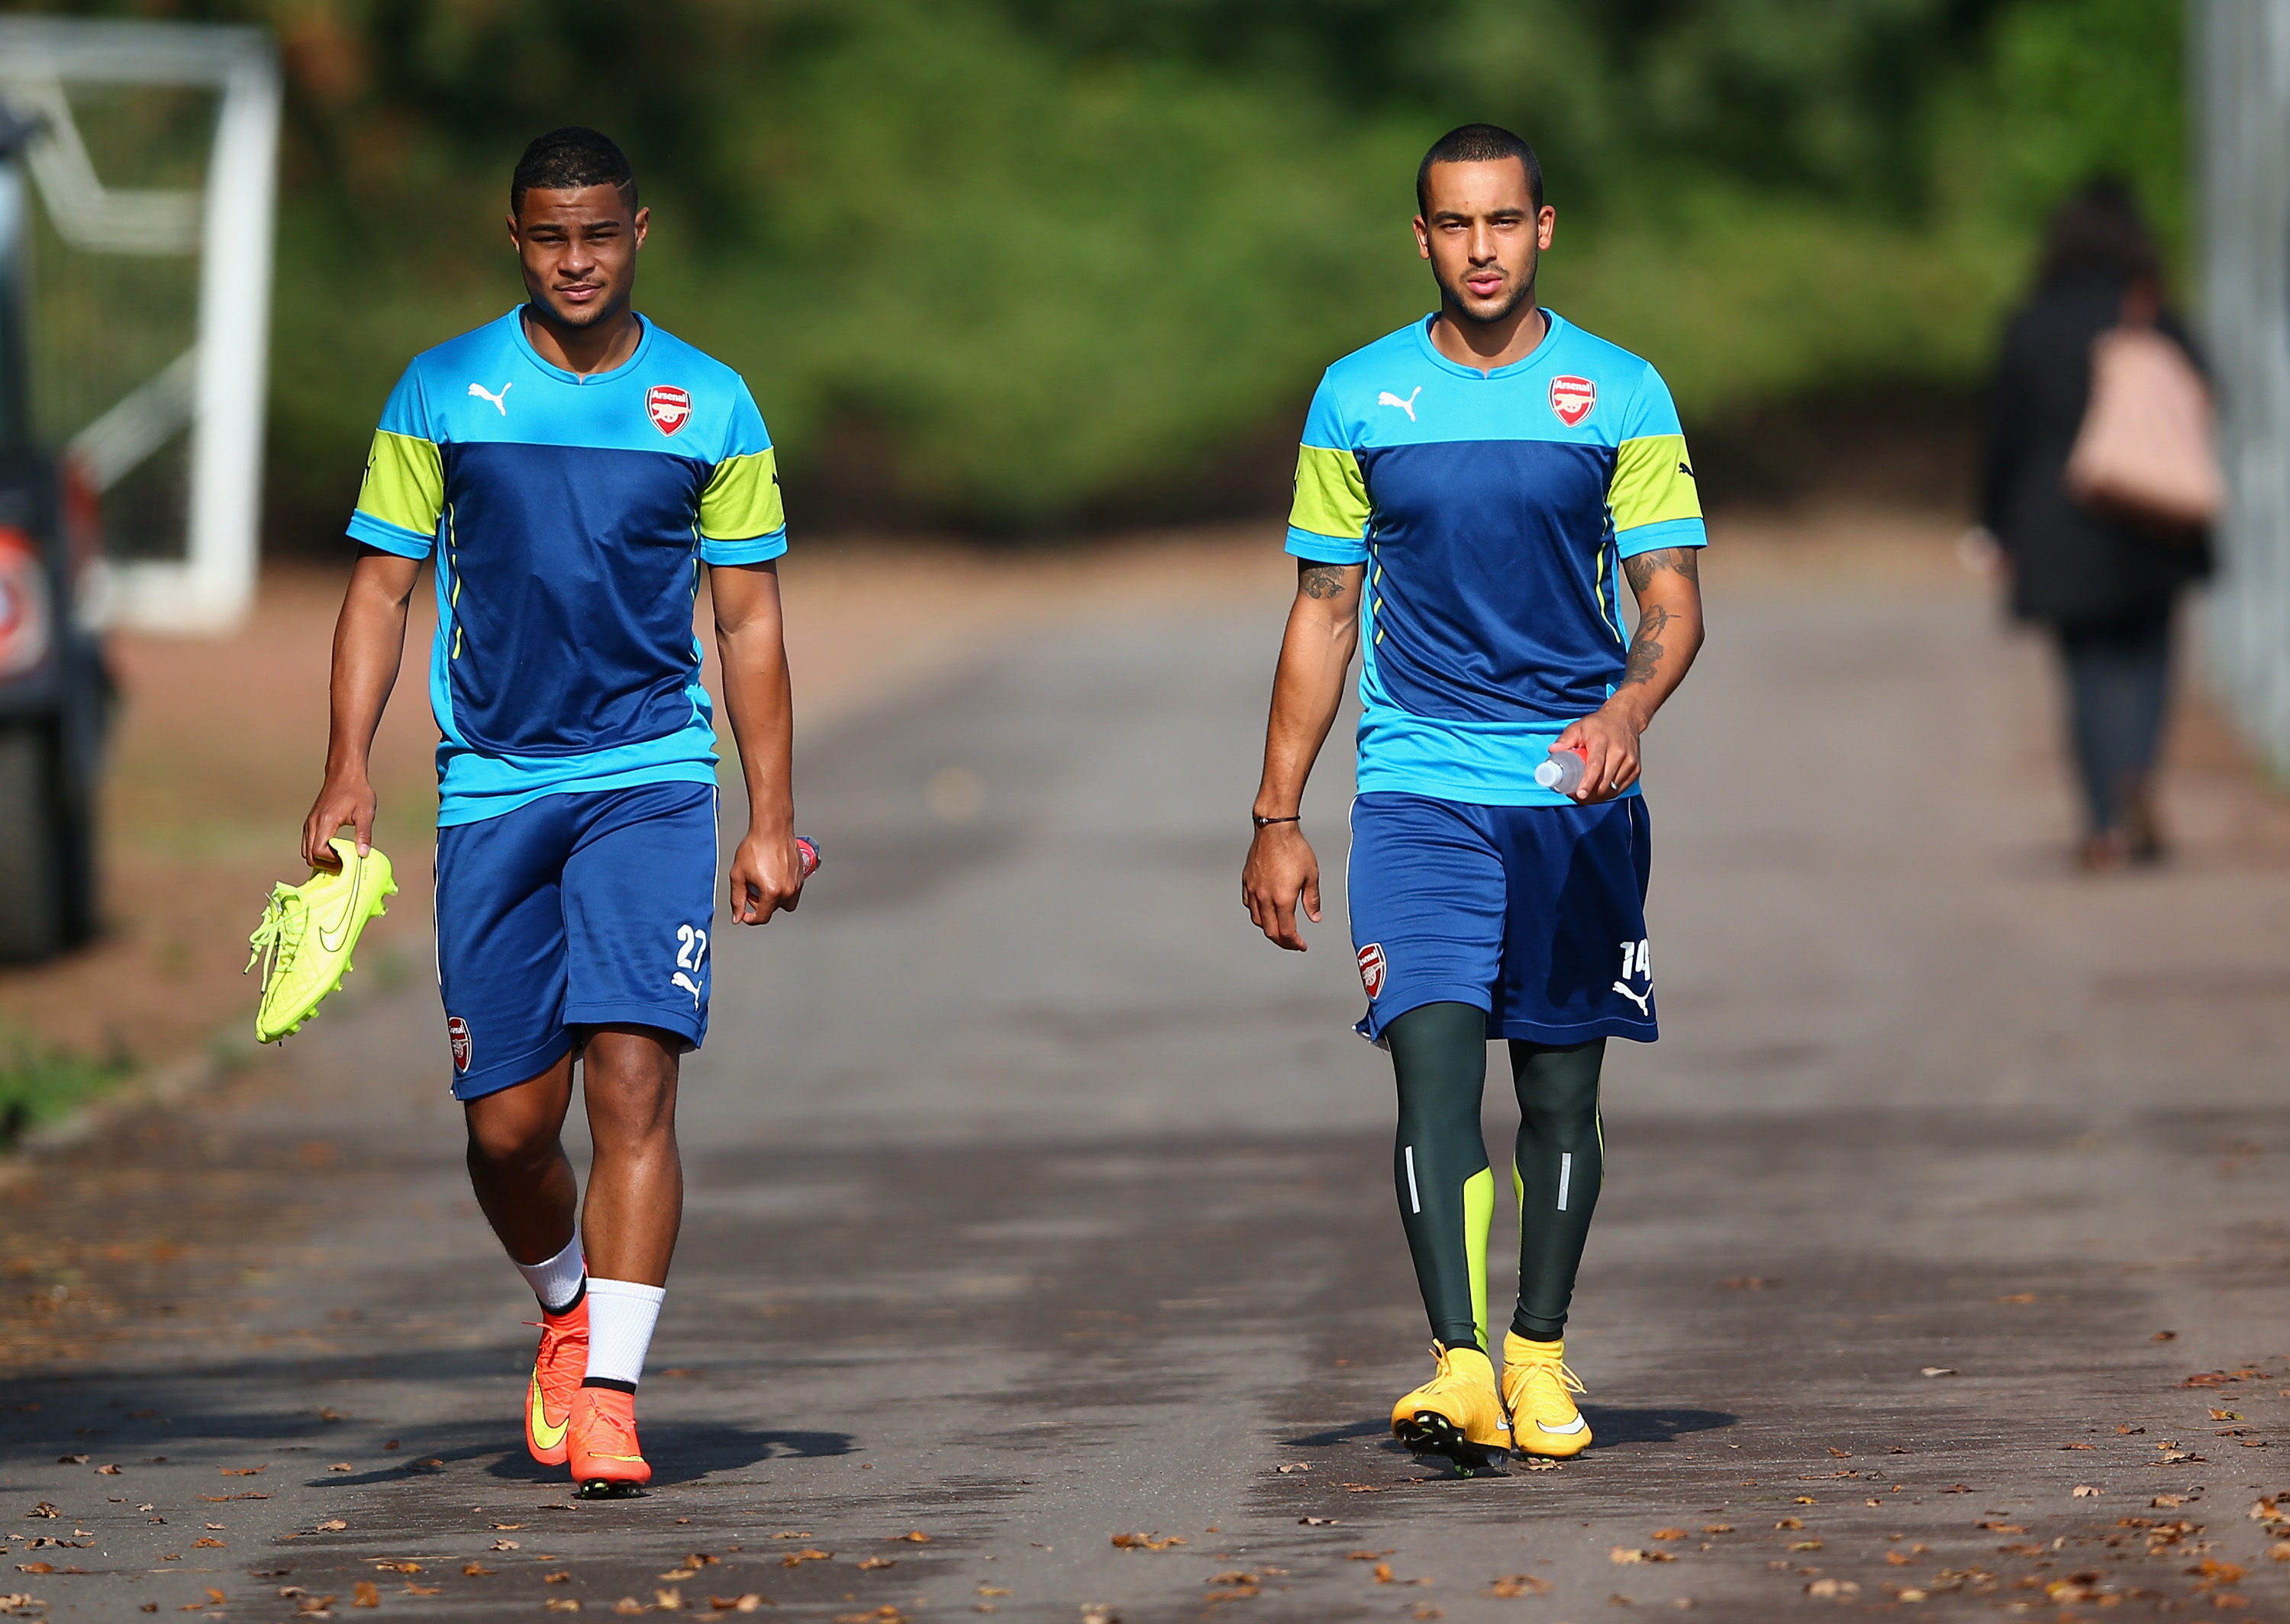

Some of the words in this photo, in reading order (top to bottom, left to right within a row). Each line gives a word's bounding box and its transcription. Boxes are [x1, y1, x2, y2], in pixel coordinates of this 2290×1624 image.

[652, 390, 686, 403] Arsenal
[1555, 380, 1591, 392] Arsenal
[677, 924, 707, 973] 27
[1620, 938, 1651, 981] 14
